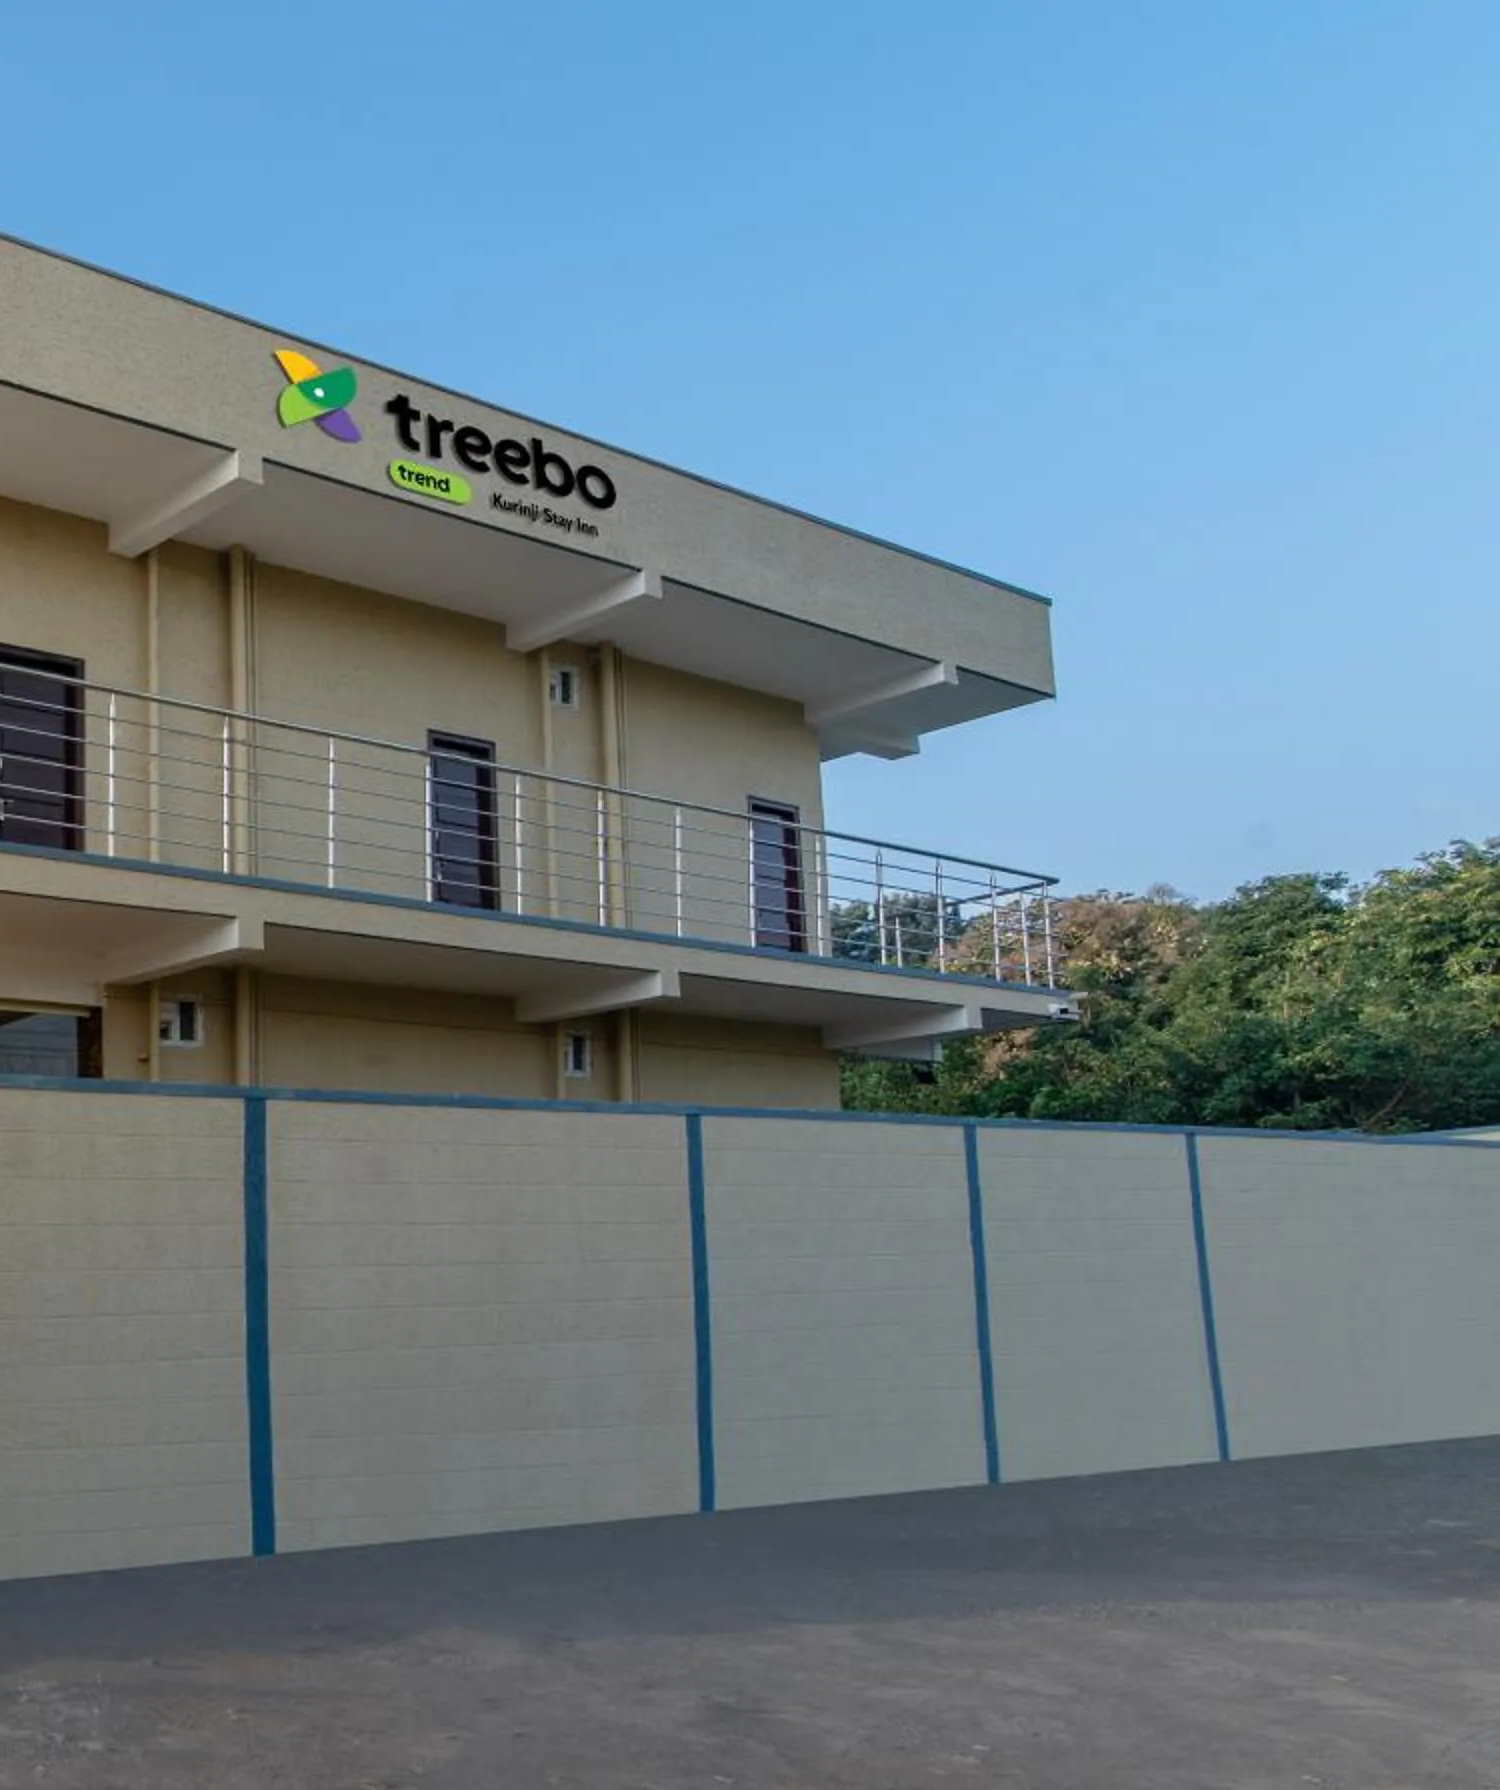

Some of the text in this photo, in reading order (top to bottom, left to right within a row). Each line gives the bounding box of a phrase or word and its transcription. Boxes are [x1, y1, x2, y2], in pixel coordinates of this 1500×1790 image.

[386, 394, 617, 510] treebo
[397, 464, 451, 494] trend
[491, 492, 599, 537] Kurinji Stay Inn
